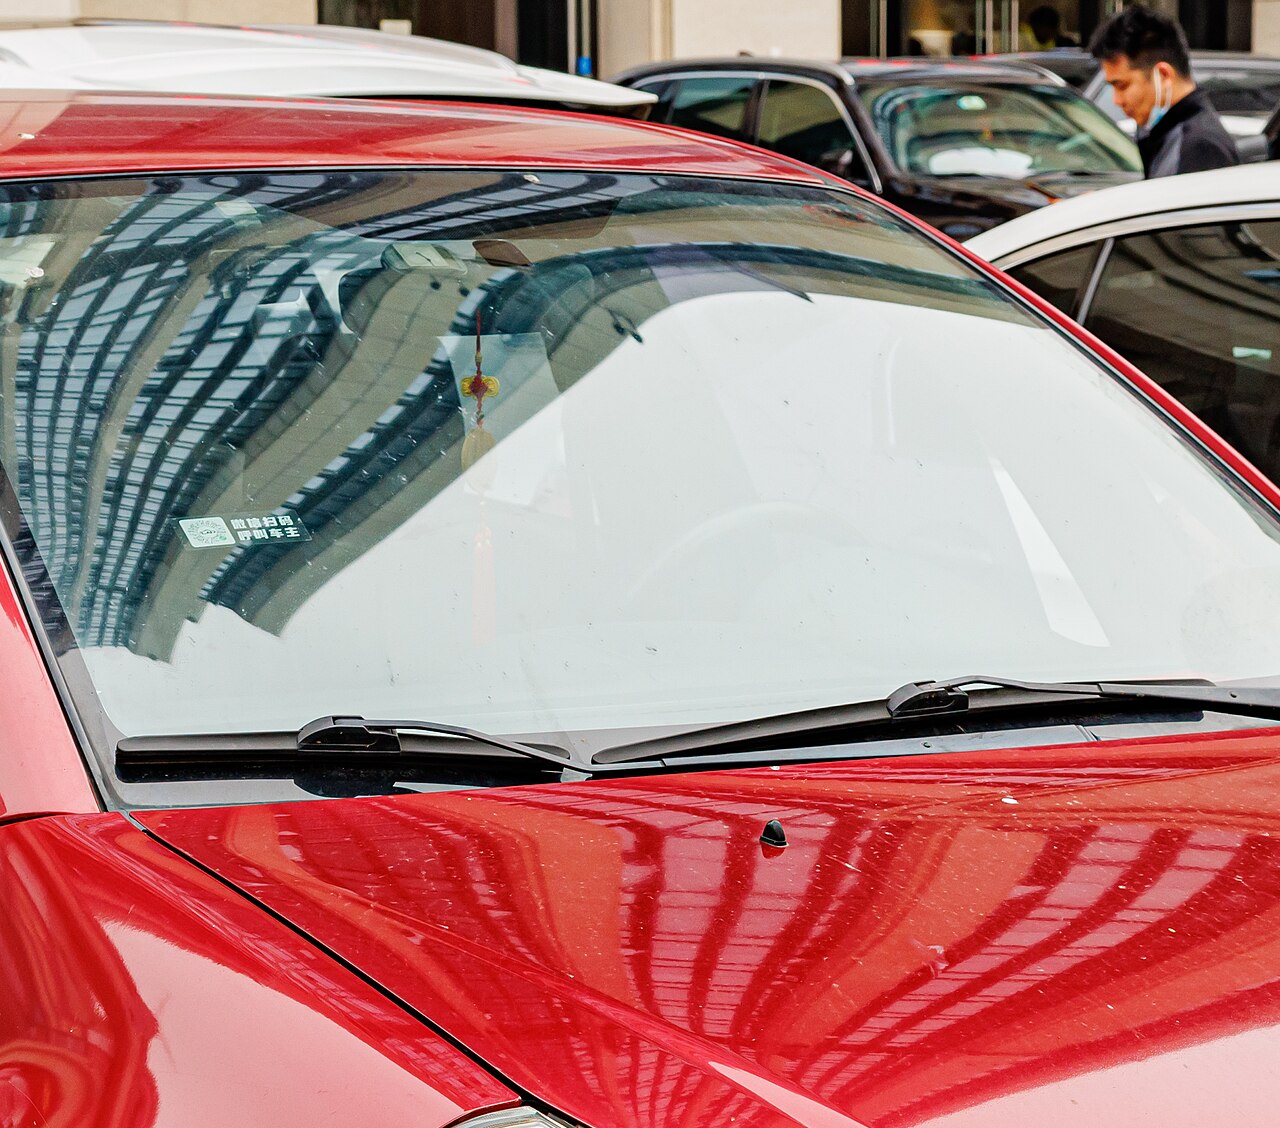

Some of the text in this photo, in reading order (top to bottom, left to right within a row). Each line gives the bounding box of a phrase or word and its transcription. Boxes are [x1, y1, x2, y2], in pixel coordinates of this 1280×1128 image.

[230, 515, 294, 530] 微信扫码
[236, 527, 301, 541] 呼叫车主
